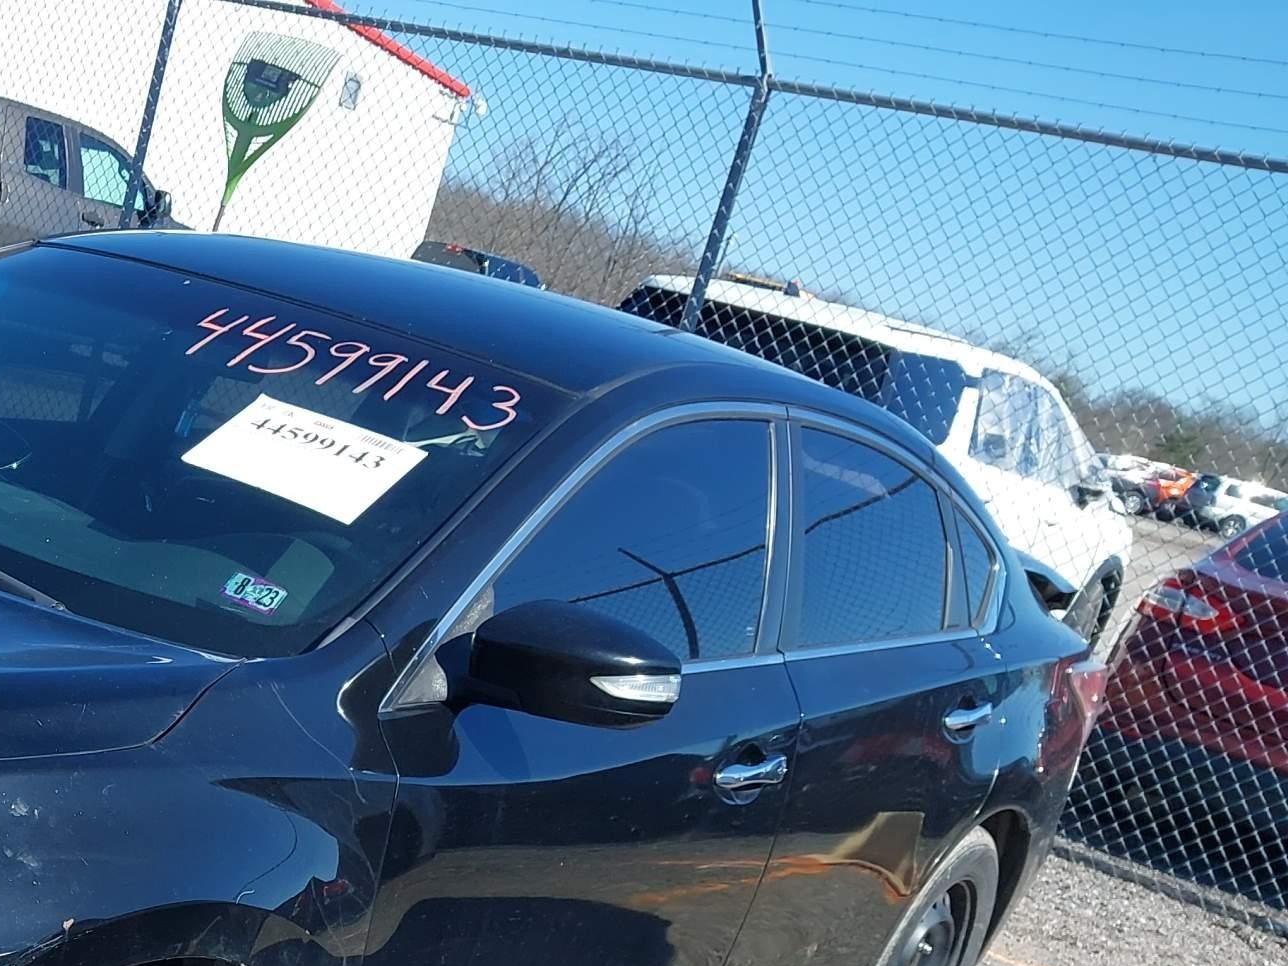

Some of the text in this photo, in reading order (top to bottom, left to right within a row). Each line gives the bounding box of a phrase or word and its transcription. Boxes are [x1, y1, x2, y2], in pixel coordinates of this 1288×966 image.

[185, 308, 520, 430] 44599143
[250, 418, 386, 468] 44599143
[255, 587, 280, 608] 23
